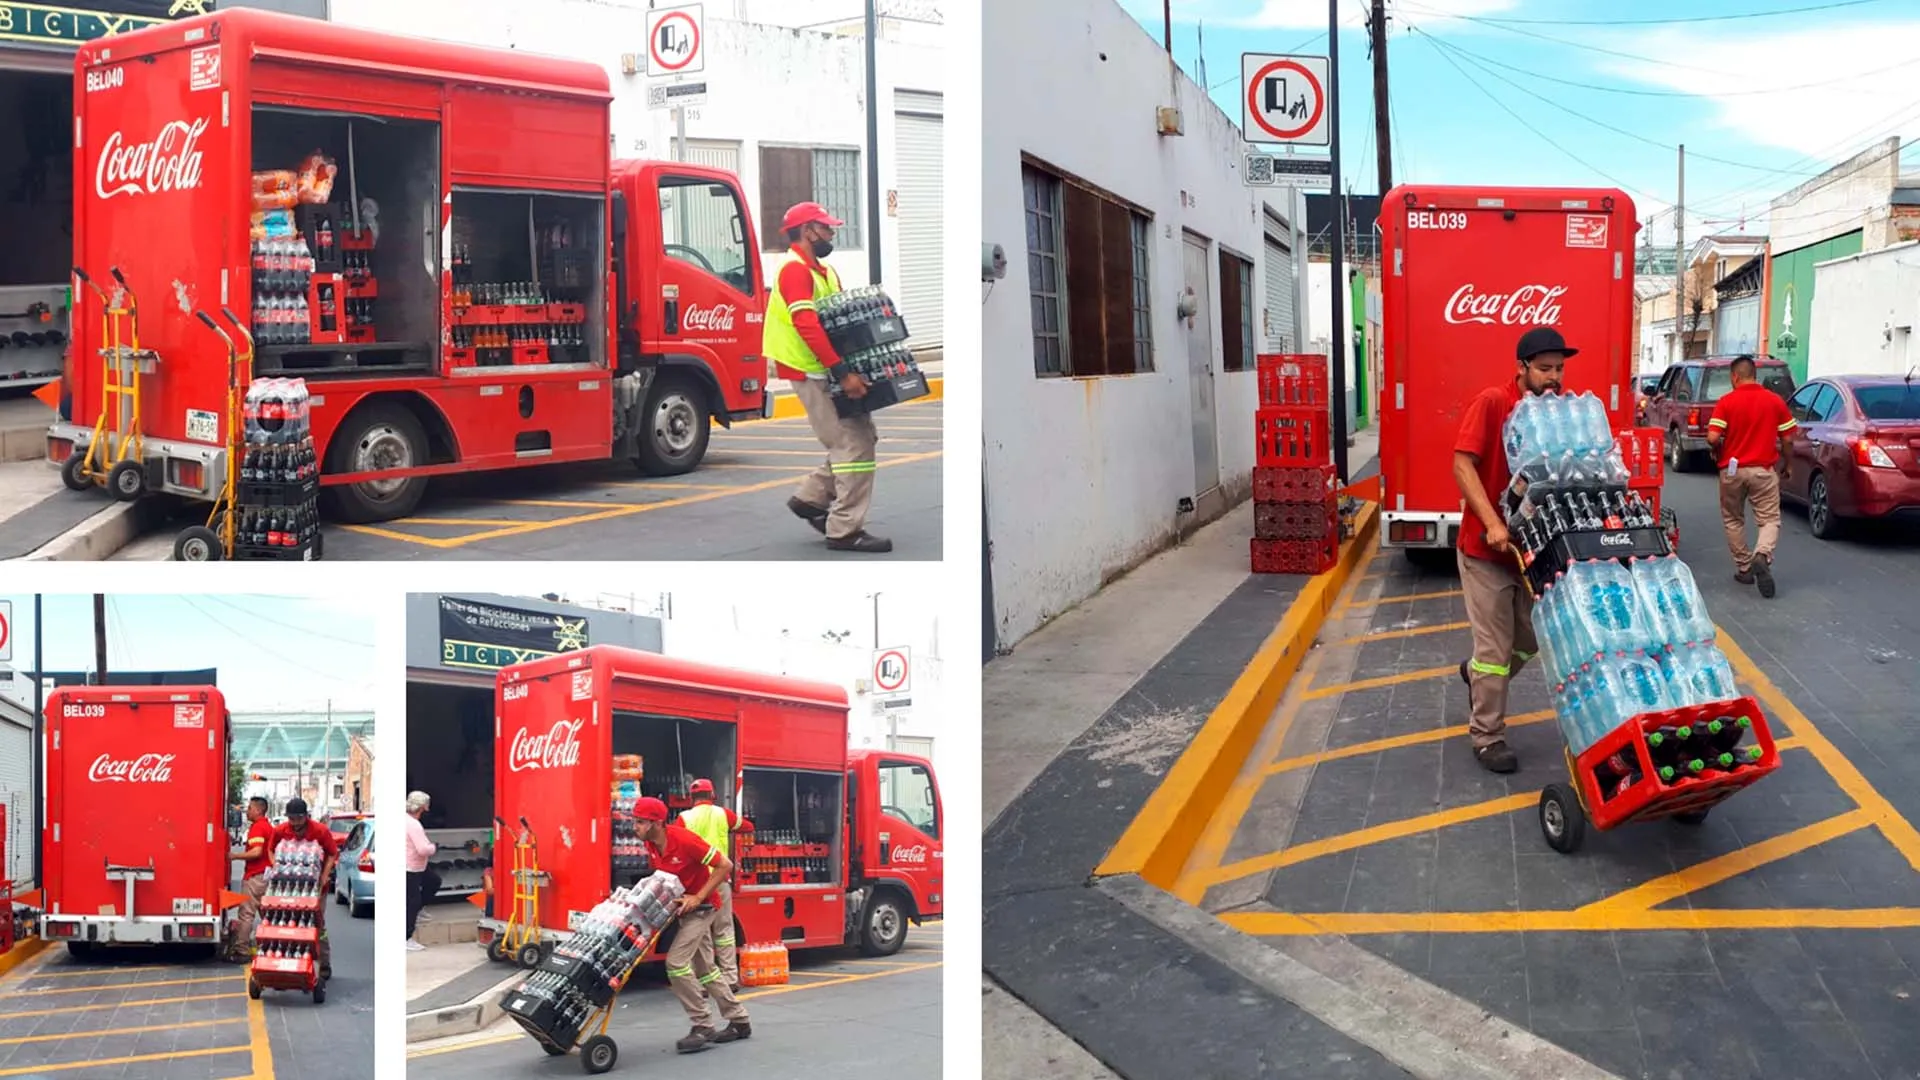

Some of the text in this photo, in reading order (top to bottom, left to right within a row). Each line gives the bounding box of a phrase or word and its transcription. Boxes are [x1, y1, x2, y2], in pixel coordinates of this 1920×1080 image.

[86, 67, 123, 92] BEL040
[96, 116, 210, 199] Coca-Cola
[1407, 211, 1467, 230] BEL039
[1444, 283, 1568, 326] Coca-Cola
[466, 615, 531, 632] de Refacciones
[480, 606, 519, 620] Bicicletas
[63, 705, 105, 718] BEL039
[509, 718, 584, 772] Coca-Cola
[88, 753, 176, 783] Coca-Cola
